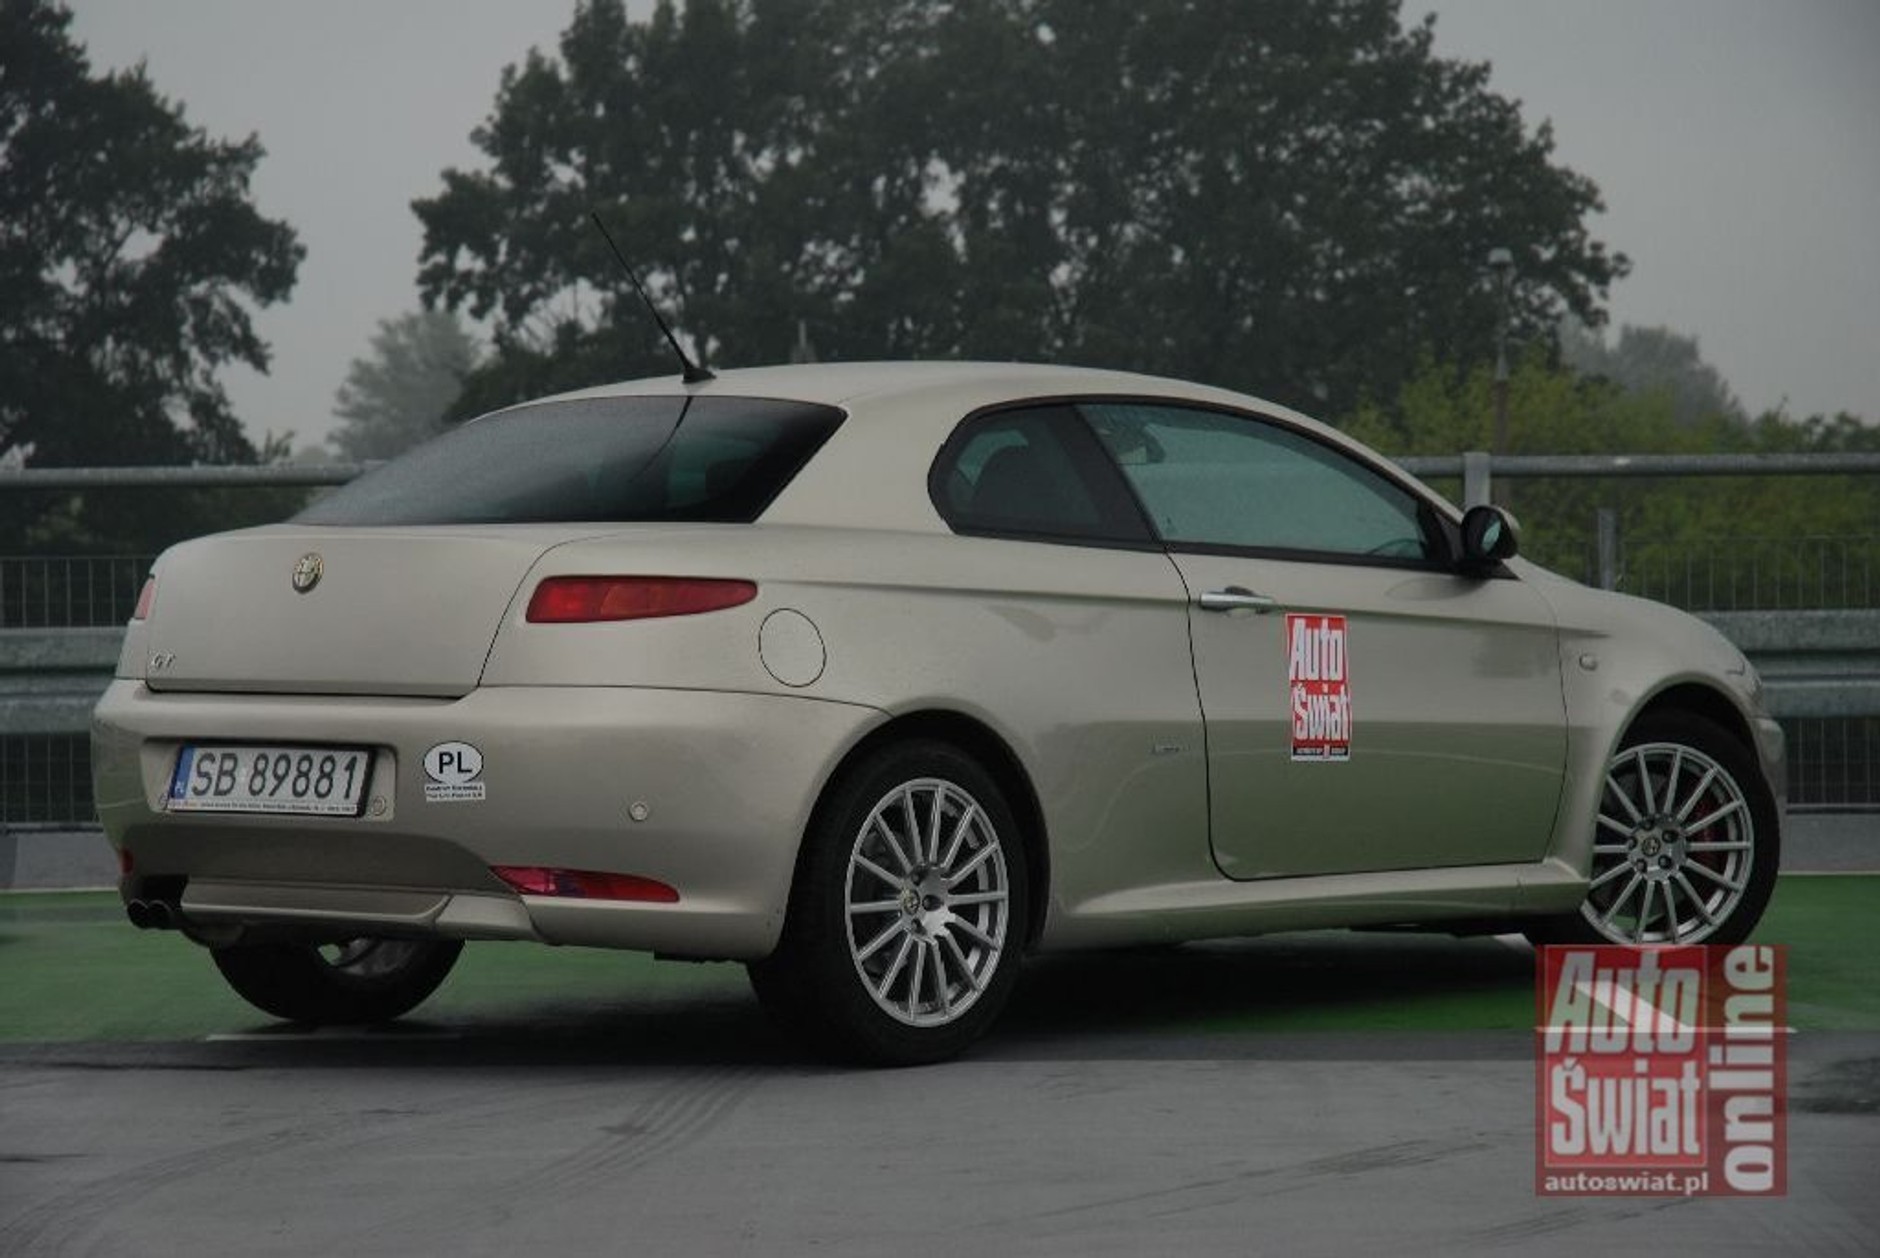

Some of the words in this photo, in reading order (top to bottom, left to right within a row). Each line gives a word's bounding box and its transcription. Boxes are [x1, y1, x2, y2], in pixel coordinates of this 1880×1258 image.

[1290, 618, 1344, 680] Auto
[192, 753, 238, 796] SB
[249, 753, 358, 799] 89881
[439, 751, 472, 774] PL
